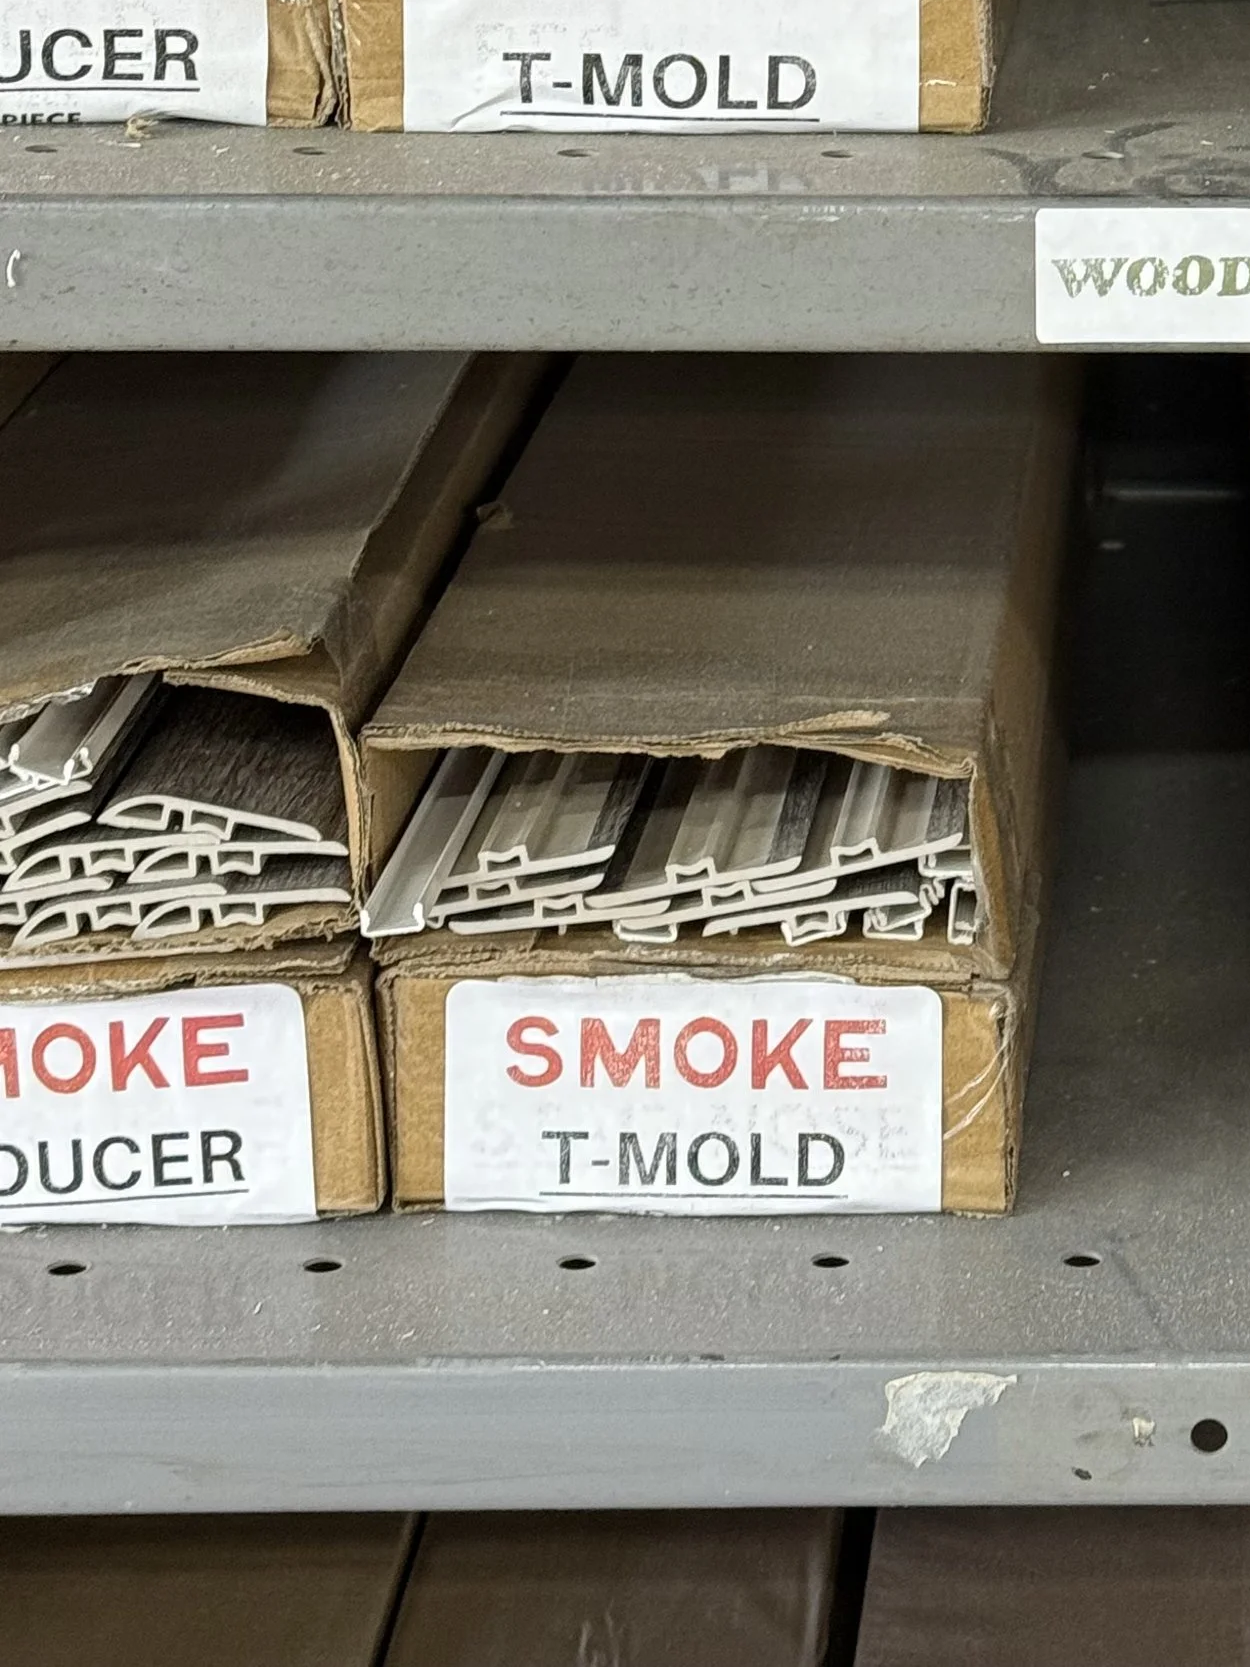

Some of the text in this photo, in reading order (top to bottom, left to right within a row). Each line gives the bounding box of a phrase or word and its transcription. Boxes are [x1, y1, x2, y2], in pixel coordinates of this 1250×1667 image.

[502, 51, 818, 110] T-MOLD
[505, 1015, 889, 1090] SMOKE
[540, 1129, 847, 1187] T-MOLD
